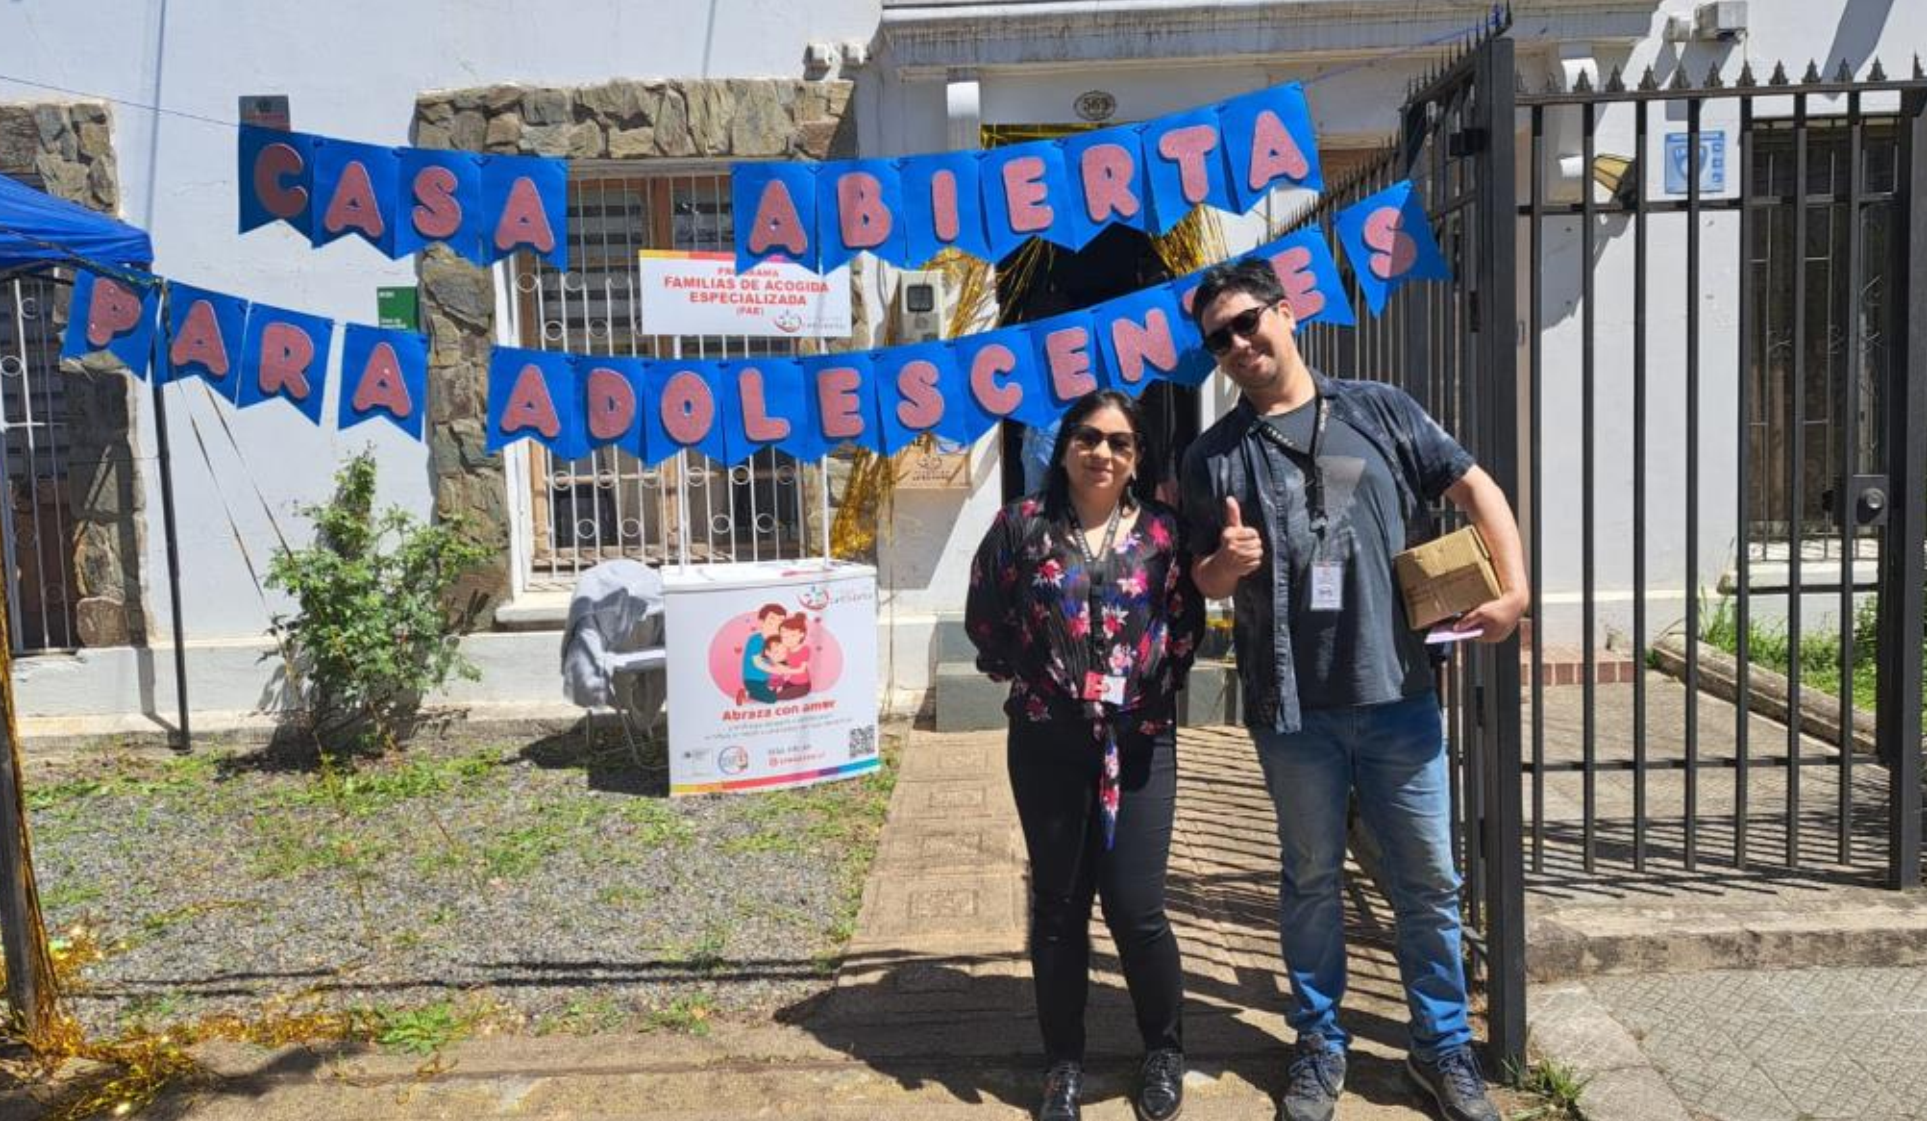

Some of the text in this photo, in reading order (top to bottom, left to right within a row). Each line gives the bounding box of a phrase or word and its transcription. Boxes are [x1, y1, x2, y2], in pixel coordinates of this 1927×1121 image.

[254, 109, 1308, 254] CASA ABIERTA
[717, 267, 779, 278] PRRAMA
[664, 275, 829, 293] FAMILIAS DE ACOGIDA
[689, 291, 807, 306] ESPECIALIZADA
[88, 207, 1417, 443] PARA ADOLESCENES
[722, 704, 772, 721] Abraza
[775, 701, 799, 715] con
